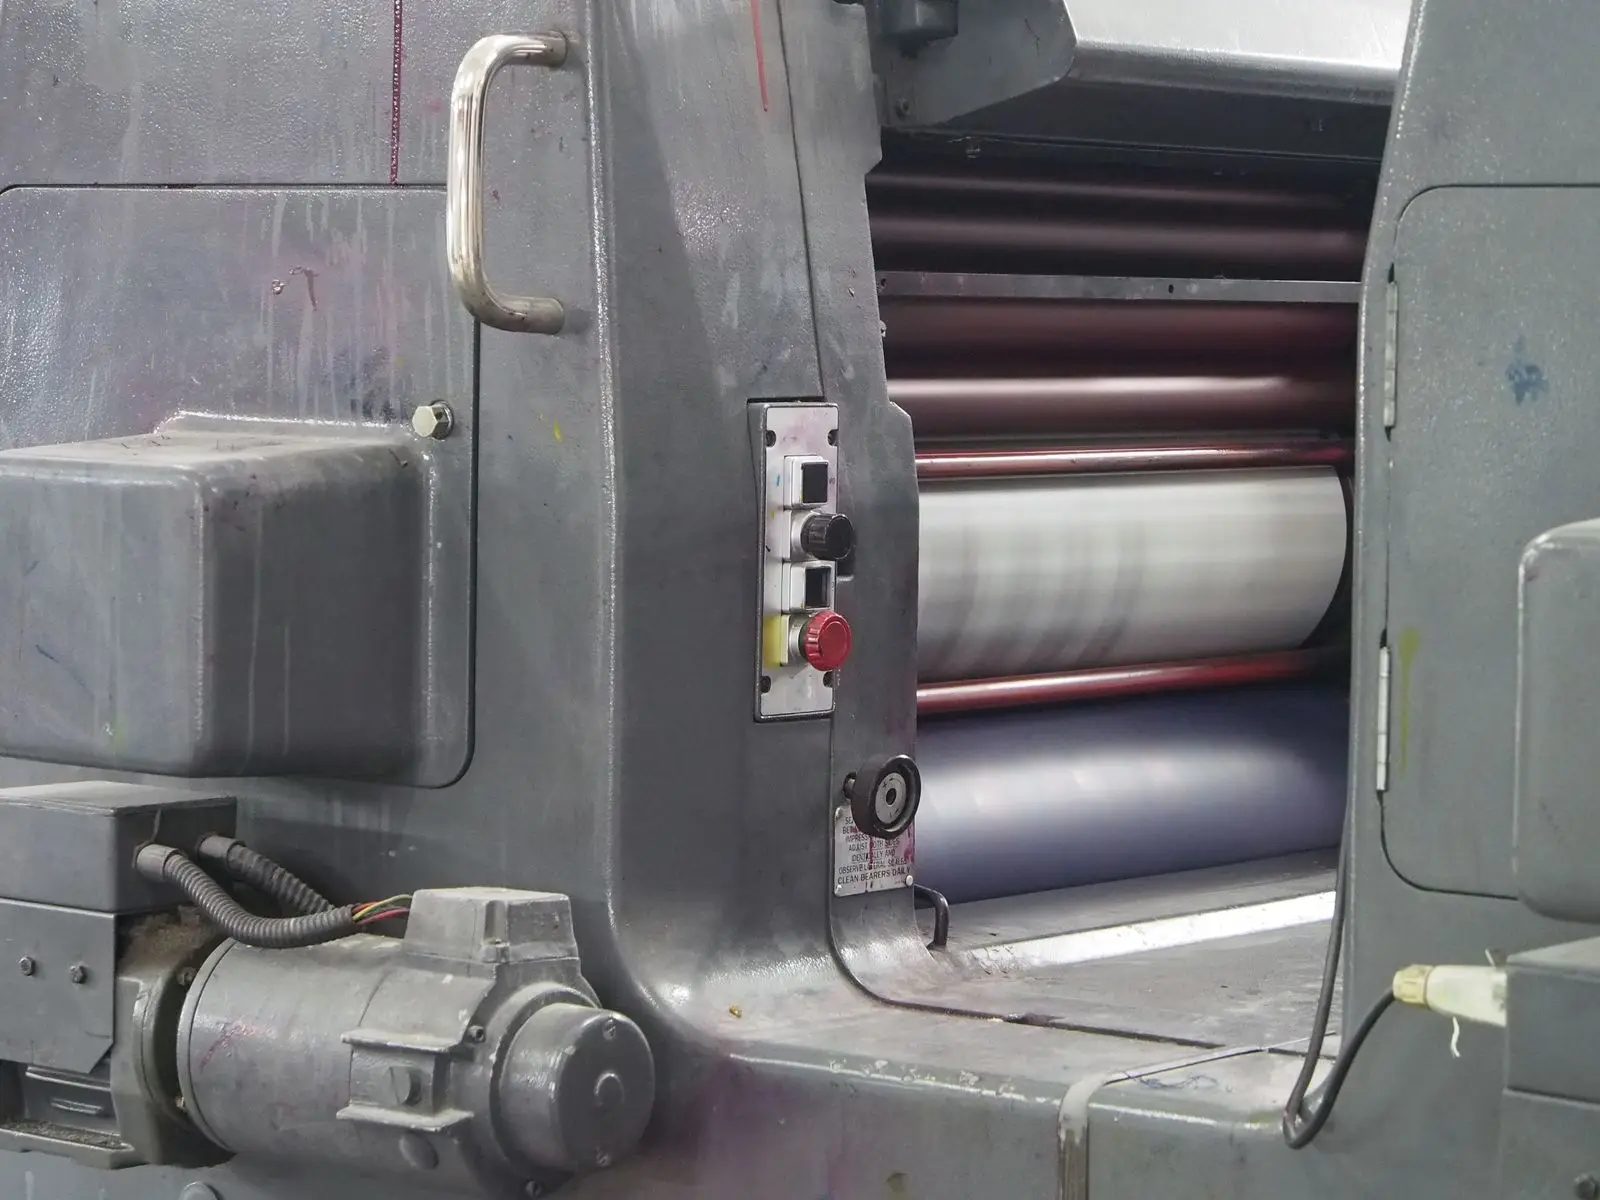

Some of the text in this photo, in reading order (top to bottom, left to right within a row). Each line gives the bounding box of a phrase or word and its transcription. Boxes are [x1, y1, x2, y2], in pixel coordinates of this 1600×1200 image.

[870, 839, 884, 849] OTH
[838, 864, 862, 875] OBSERVE
[837, 866, 911, 885] CLEAN BEARERS DAILY
